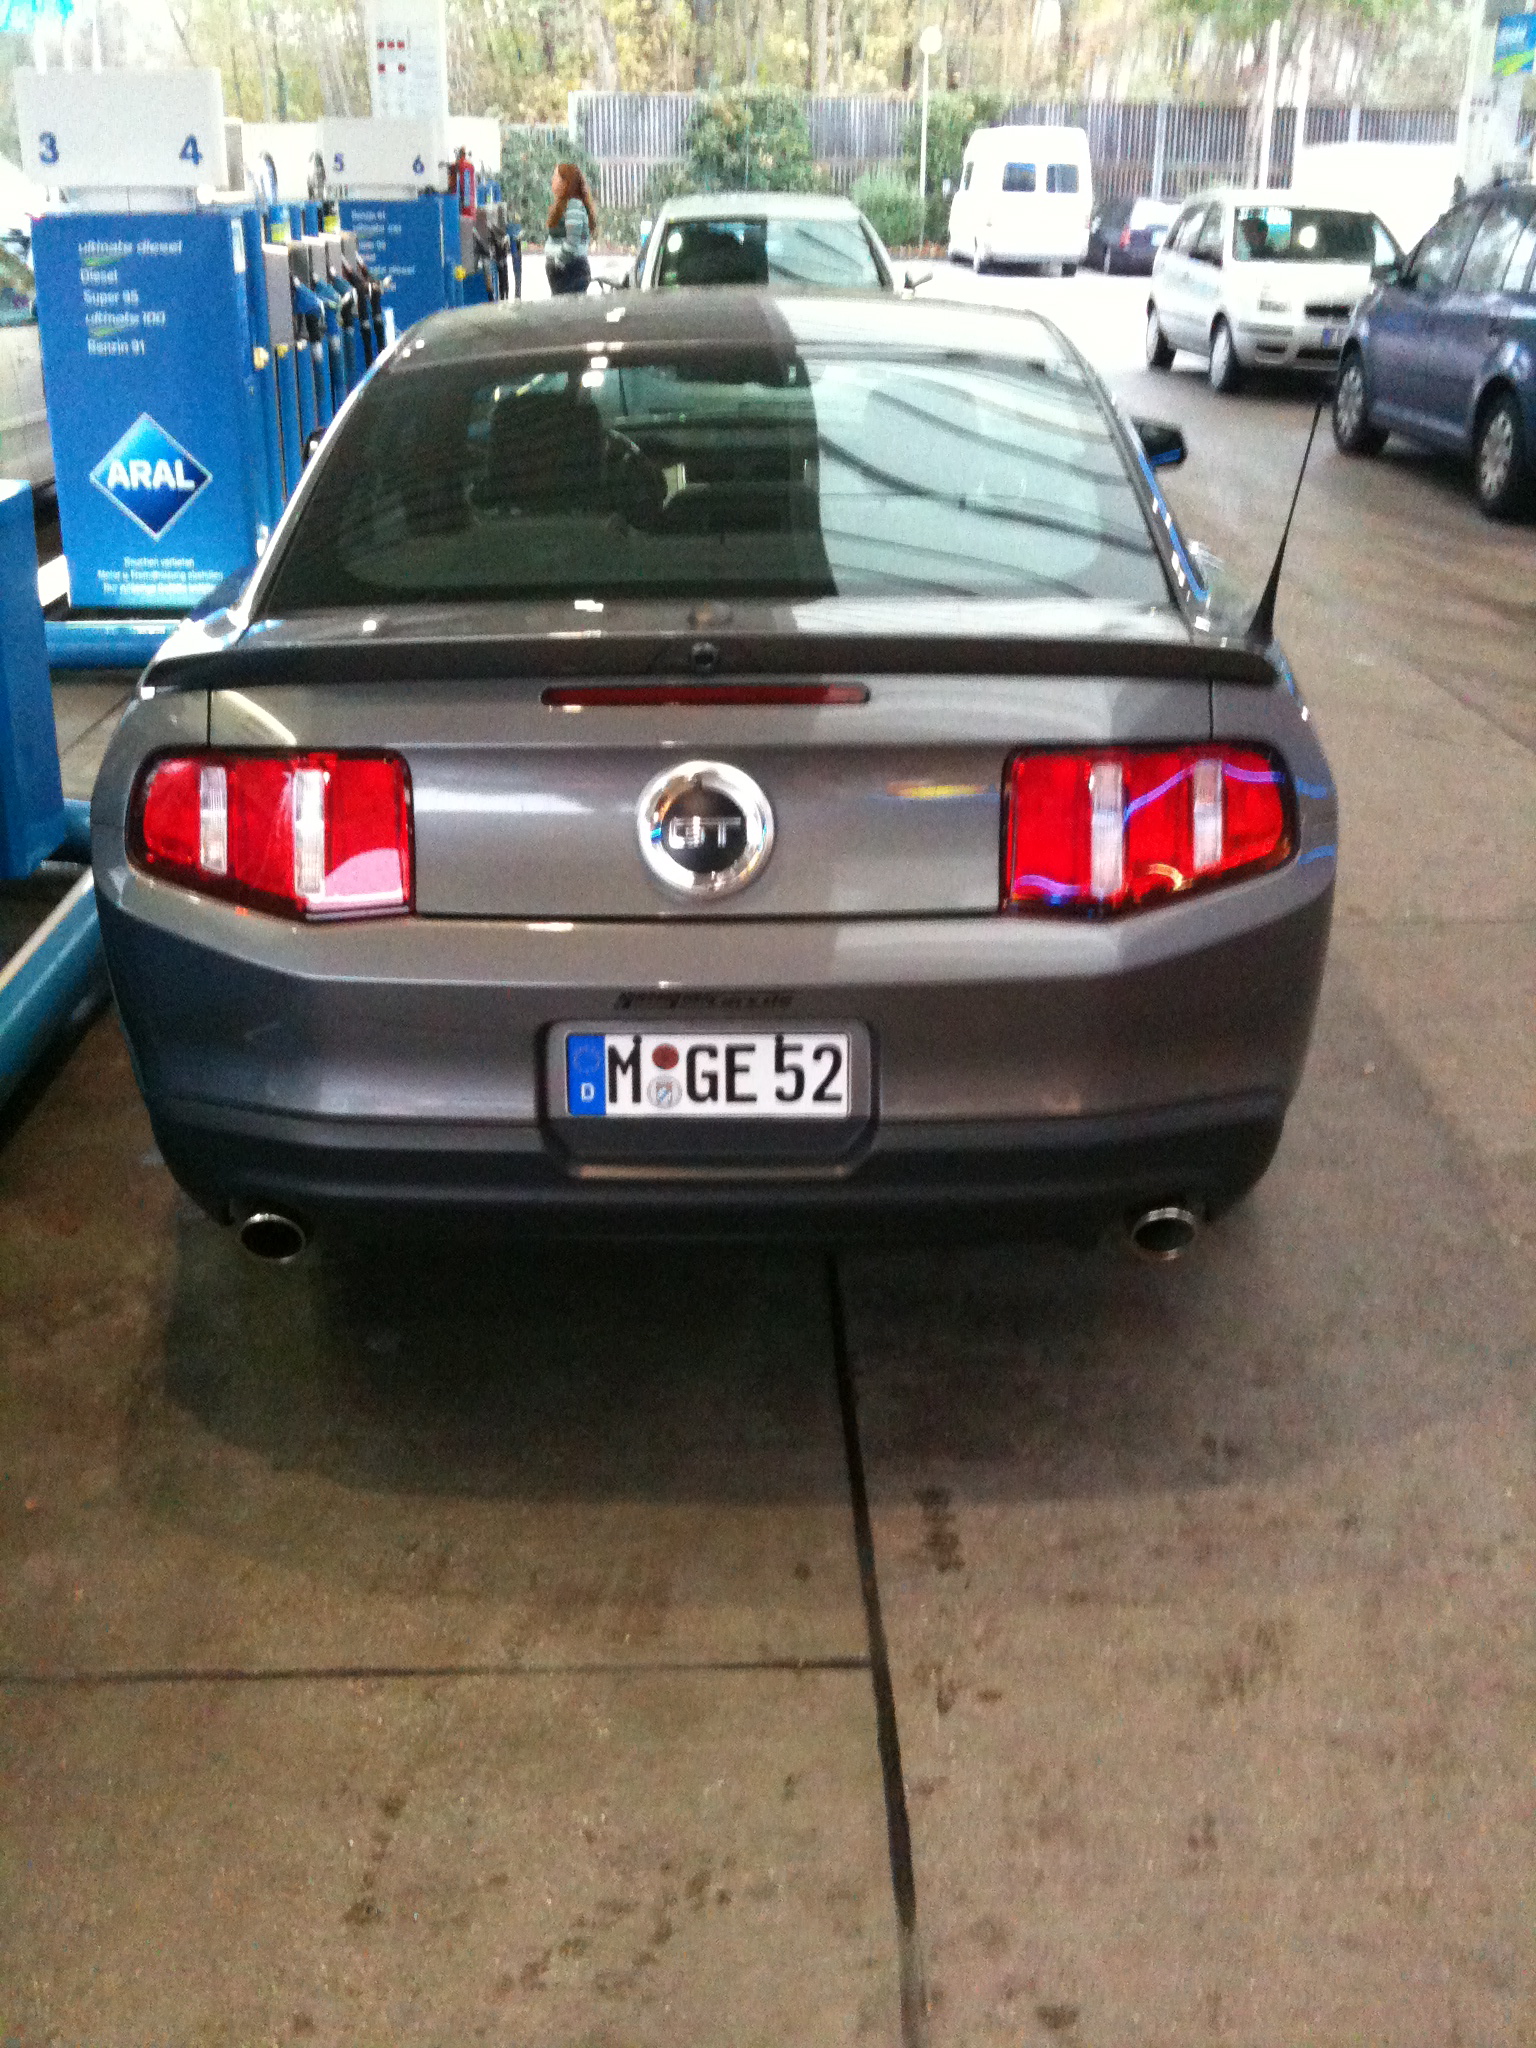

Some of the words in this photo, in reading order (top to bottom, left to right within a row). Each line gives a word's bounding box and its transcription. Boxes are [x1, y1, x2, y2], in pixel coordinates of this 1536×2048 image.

[37, 131, 60, 166] 3
[178, 133, 203, 166] 4
[332, 152, 346, 173] 5
[411, 154, 425, 176] 6
[136, 240, 183, 255] diesel
[80, 268, 118, 285] Diesel
[83, 290, 120, 307] Super
[106, 459, 196, 491] ARAL
[667, 815, 743, 850] GT
[607, 1040, 643, 1104] M
[685, 1042, 758, 1104] GE
[773, 1037, 844, 1104] 52
